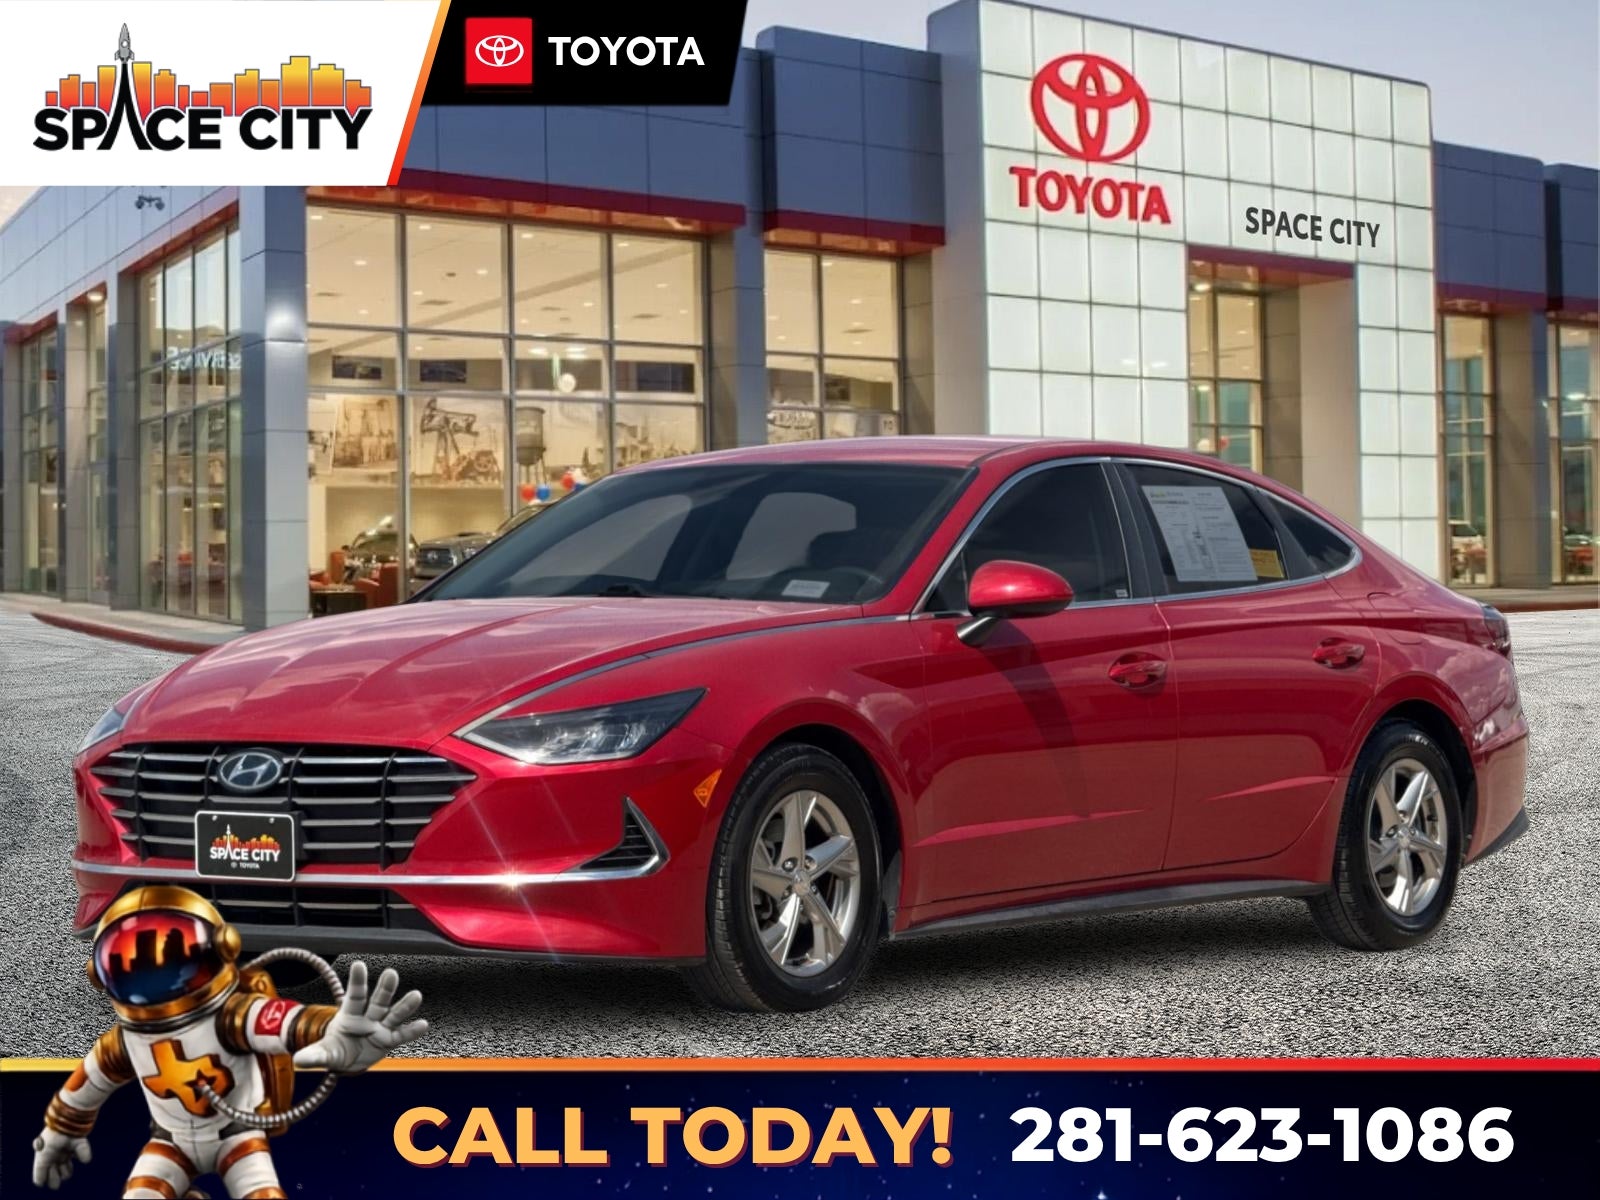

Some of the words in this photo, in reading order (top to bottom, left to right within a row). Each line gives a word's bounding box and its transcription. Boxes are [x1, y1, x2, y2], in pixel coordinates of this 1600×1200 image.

[1009, 166, 1171, 224] TOYOTA
[1245, 207, 1322, 241] SPACE
[1330, 217, 1381, 248] CITY
[210, 846, 249, 861] SPACE
[251, 849, 281, 862] CITY
